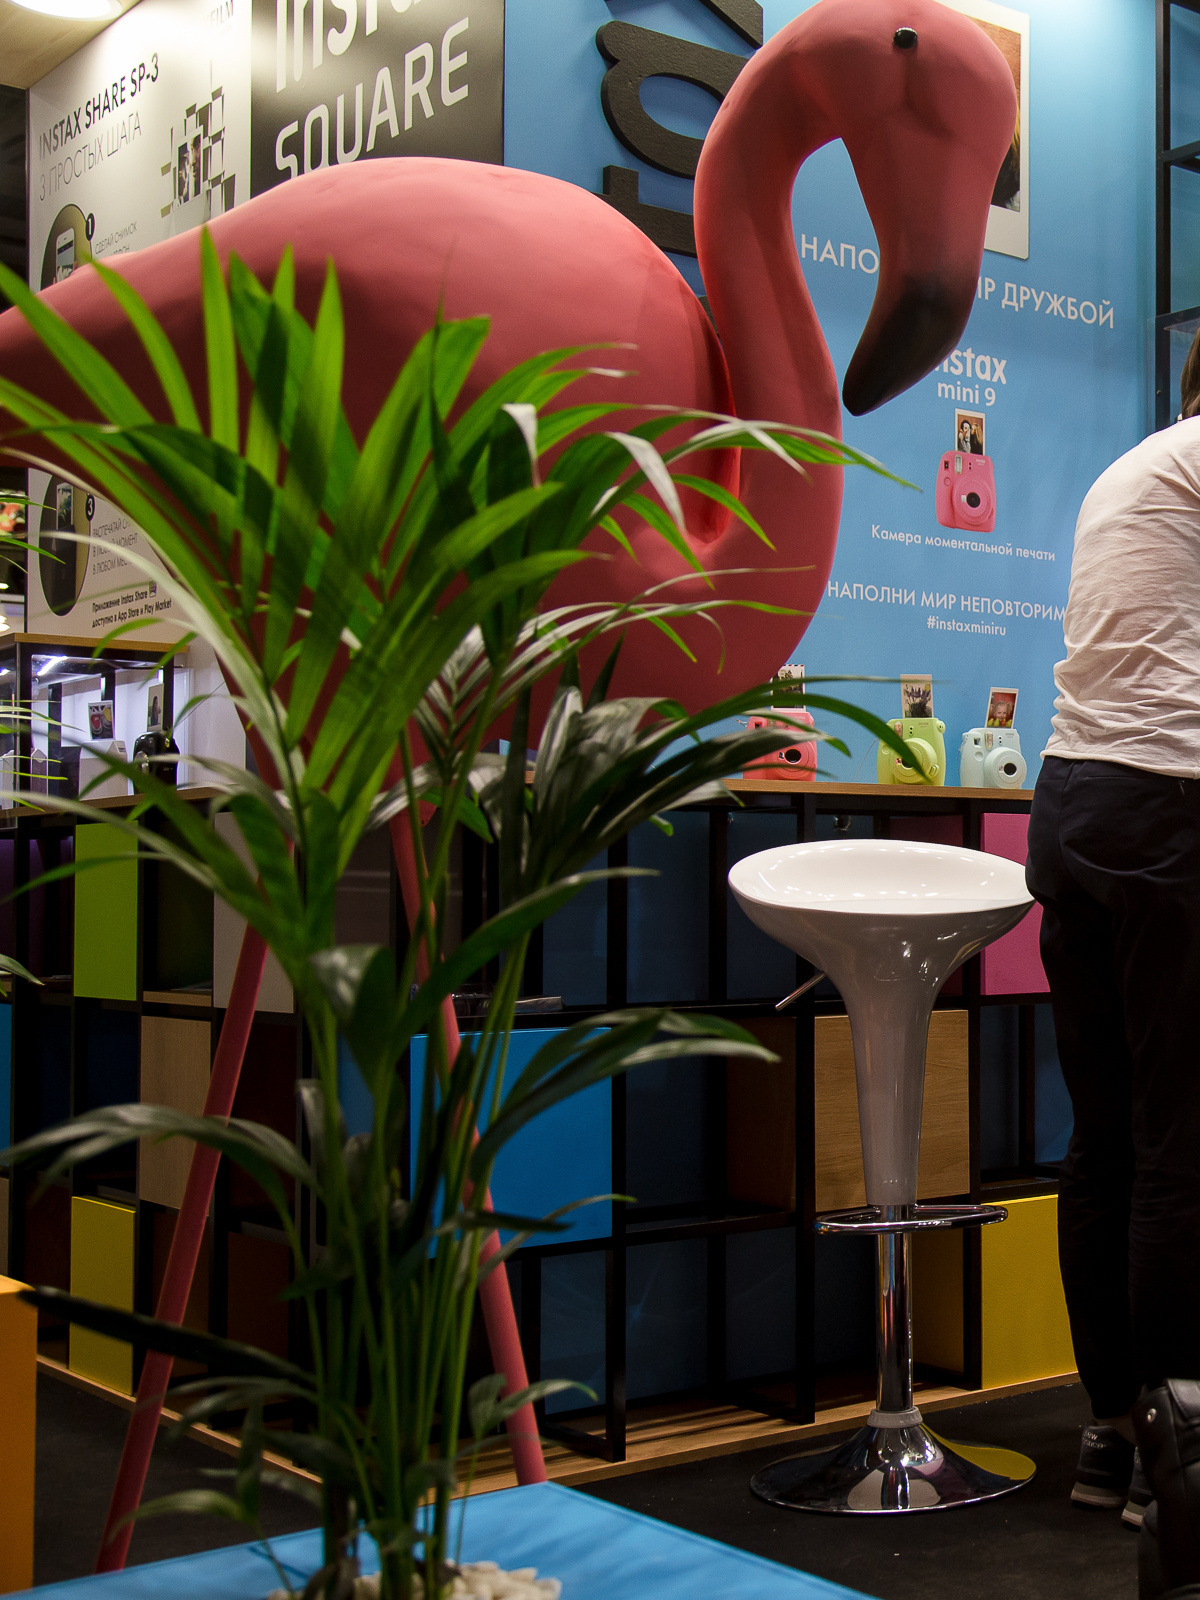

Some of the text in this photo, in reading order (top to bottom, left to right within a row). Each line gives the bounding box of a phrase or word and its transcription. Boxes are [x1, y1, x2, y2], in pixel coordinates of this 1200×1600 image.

[39, 52, 159, 161] INSTAX SHARE SP-3
[275, 16, 469, 179] SQUARE
[40, 111, 142, 201] 3 ПРОСТЫХ ШАГА
[801, 233, 880, 274] НАПО
[1001, 280, 1114, 329] ДРУЖБОЙ
[935, 347, 1007, 385] stax
[937, 380, 996, 407] mini 9
[871, 524, 1055, 562] Камера моментальной печати
[118, 611, 127, 622] App
[155, 598, 172, 612] Market
[827, 580, 1066, 621] НАПОЛНИ МИР НЕПОВТОРИМ
[927, 615, 1007, 636] #instaxminiru
